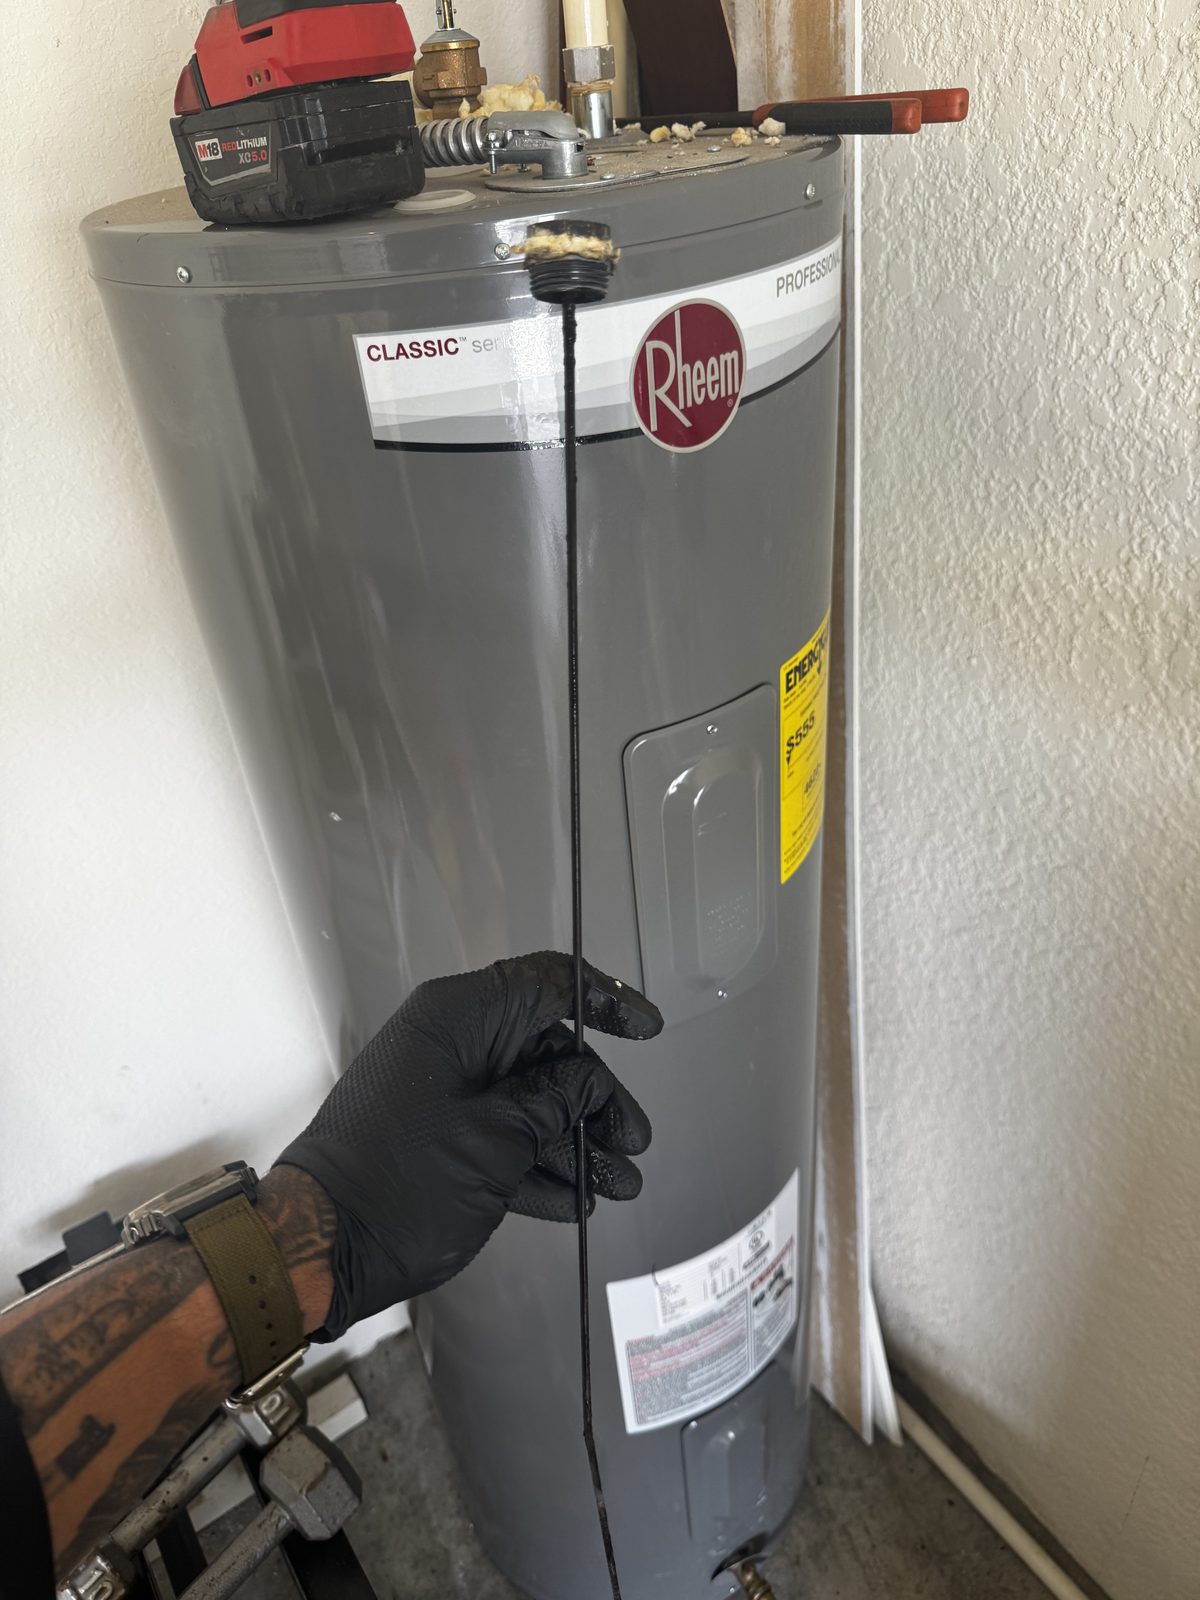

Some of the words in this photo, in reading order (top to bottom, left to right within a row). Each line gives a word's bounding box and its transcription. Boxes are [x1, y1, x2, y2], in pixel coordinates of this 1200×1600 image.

[197, 141, 220, 159] M18
[221, 136, 268, 152] REDLITHIUM
[239, 149, 267, 164] XC5.0
[776, 248, 841, 298] PROFESSION
[645, 309, 740, 433] Rheem
